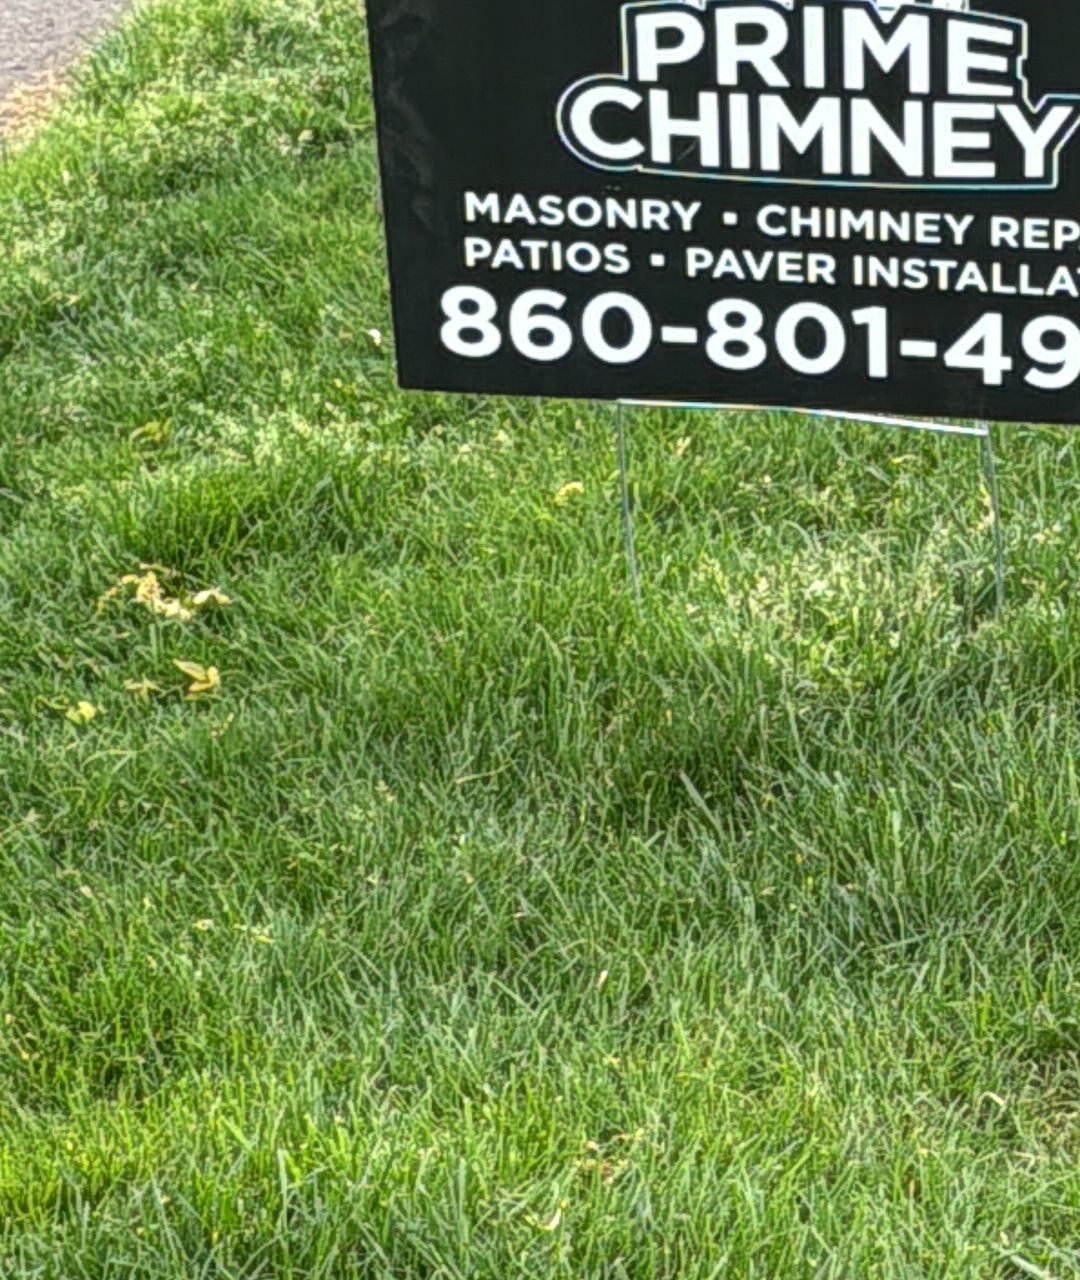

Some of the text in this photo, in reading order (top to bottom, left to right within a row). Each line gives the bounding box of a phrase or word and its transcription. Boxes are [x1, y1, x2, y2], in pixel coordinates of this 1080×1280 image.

[635, 5, 1014, 97] PRIME
[569, 85, 1073, 178] CHIMNEY
[464, 191, 702, 232] MASONRY
[756, 204, 974, 245] CHIMNEY
[464, 236, 631, 274] PATIOS
[686, 247, 836, 285] PAVER
